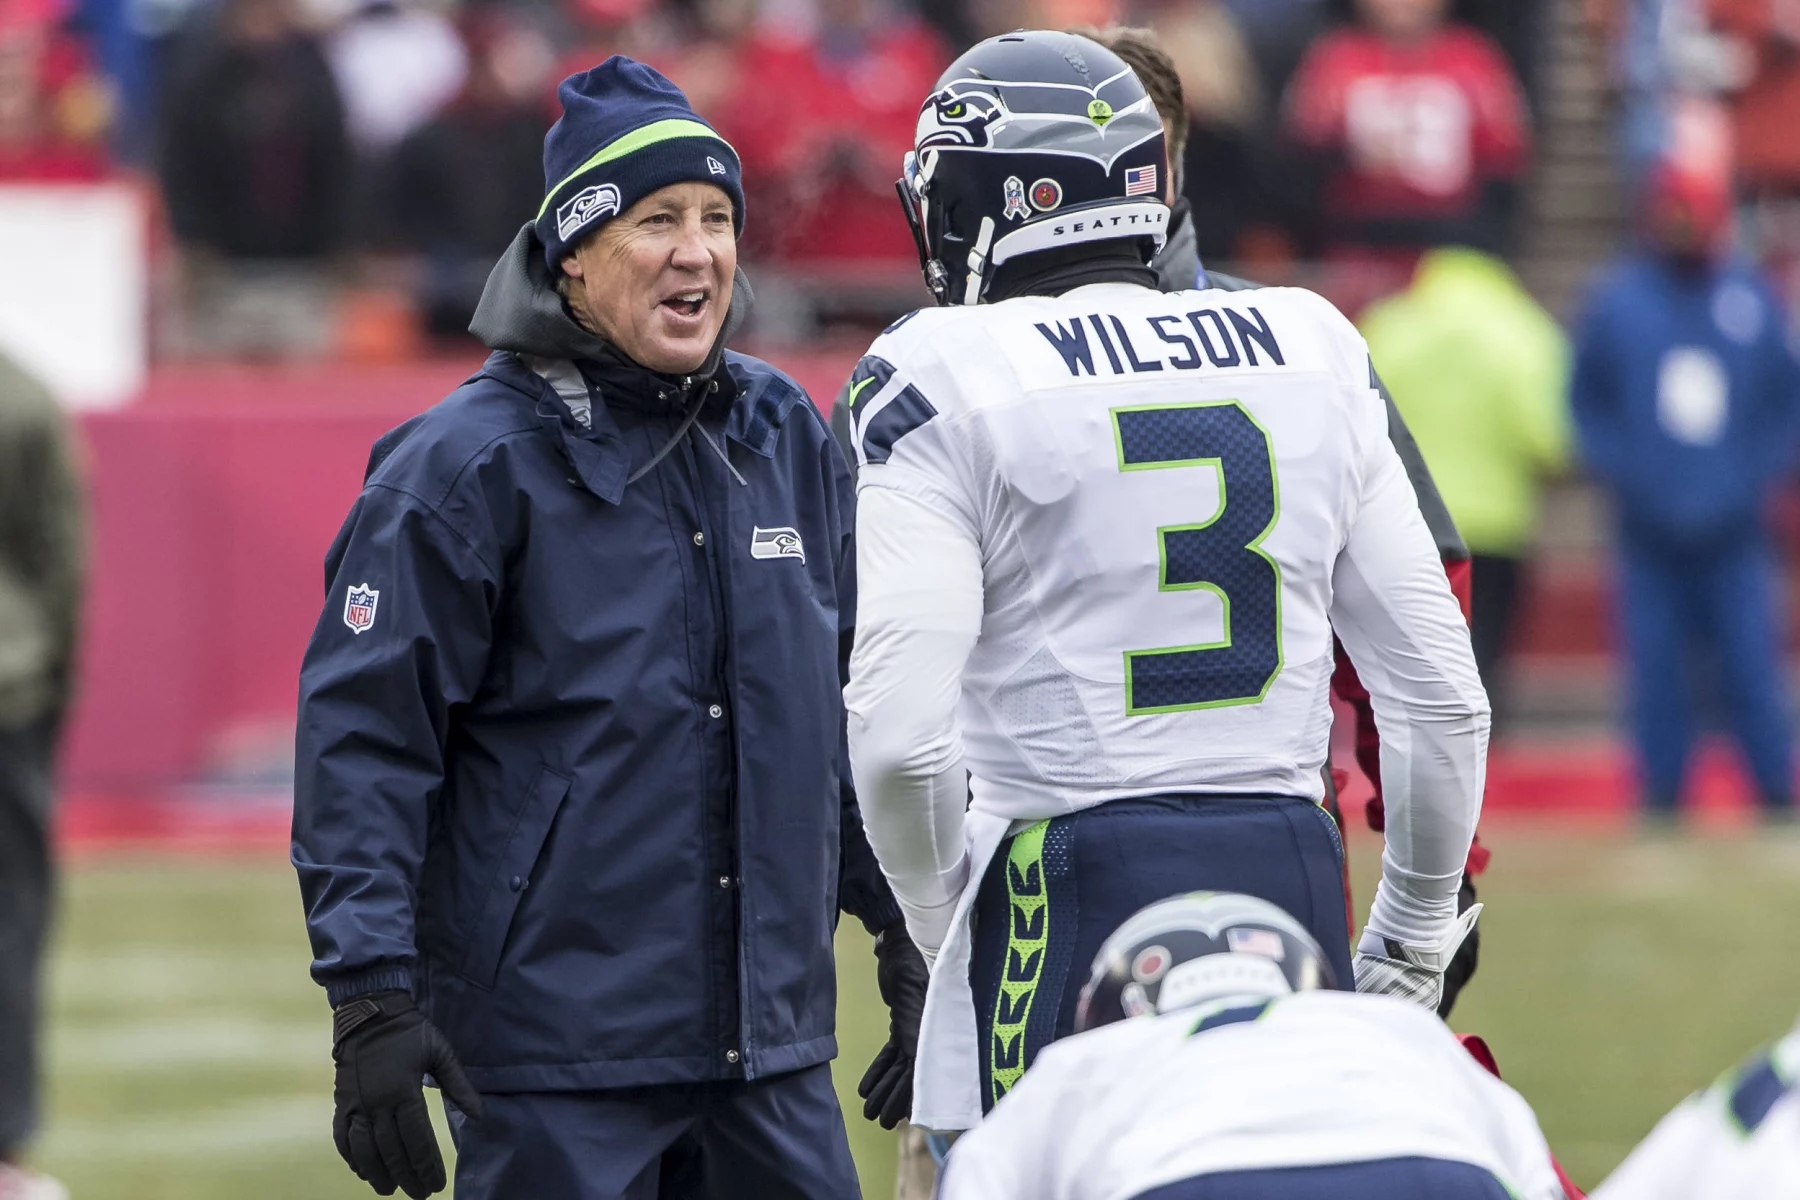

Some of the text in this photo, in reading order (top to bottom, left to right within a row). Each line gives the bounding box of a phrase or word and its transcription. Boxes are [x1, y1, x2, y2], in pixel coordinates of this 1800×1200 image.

[1053, 213, 1162, 236] SEATTLE
[1033, 306, 1286, 377] WILSON
[1108, 398, 1285, 717] 3
[349, 605, 369, 624] NFL
